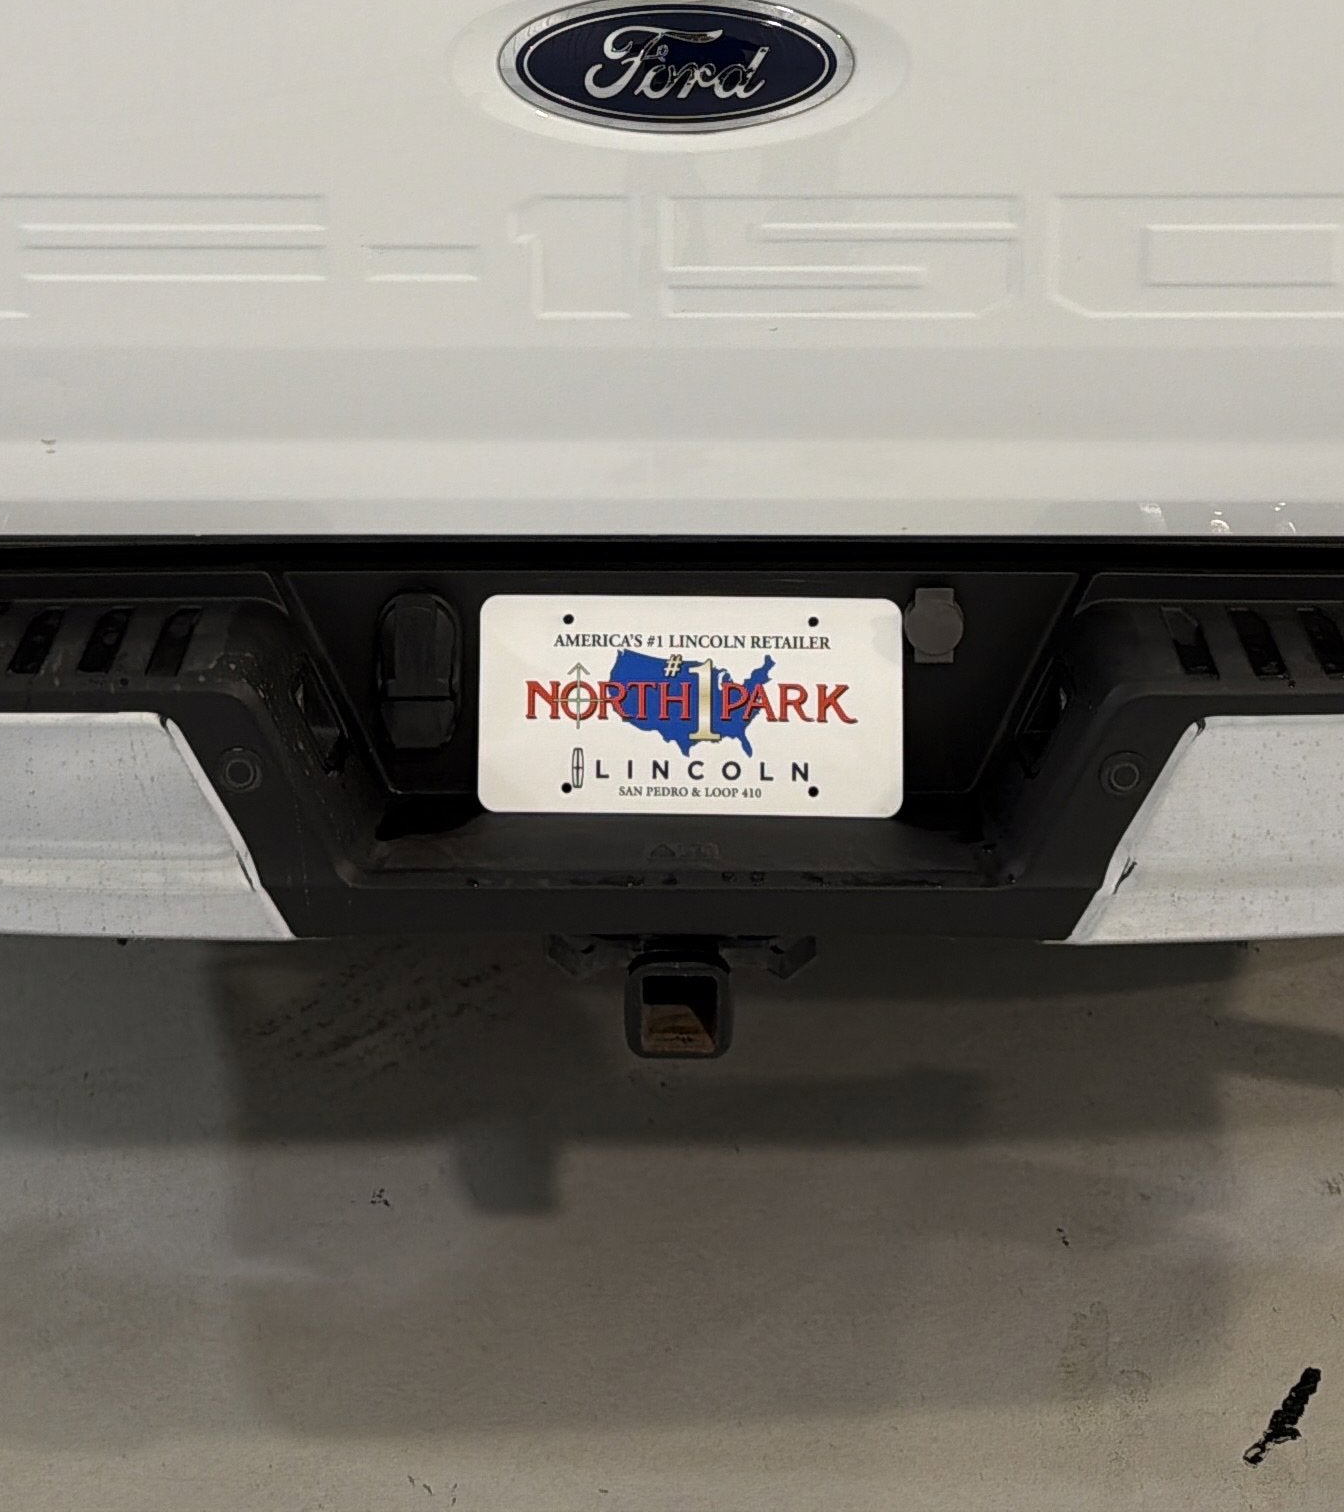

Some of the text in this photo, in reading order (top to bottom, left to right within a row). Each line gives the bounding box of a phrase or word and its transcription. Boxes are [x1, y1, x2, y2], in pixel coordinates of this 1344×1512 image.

[584, 25, 770, 99] Ford
[553, 634, 831, 650] AMERICA'S #1 LINCOLN RETAILER
[525, 679, 859, 724] NORTH PARK
[595, 759, 809, 782] LINCOLN
[618, 786, 762, 799] SAN PEDRO & LOOP 410
